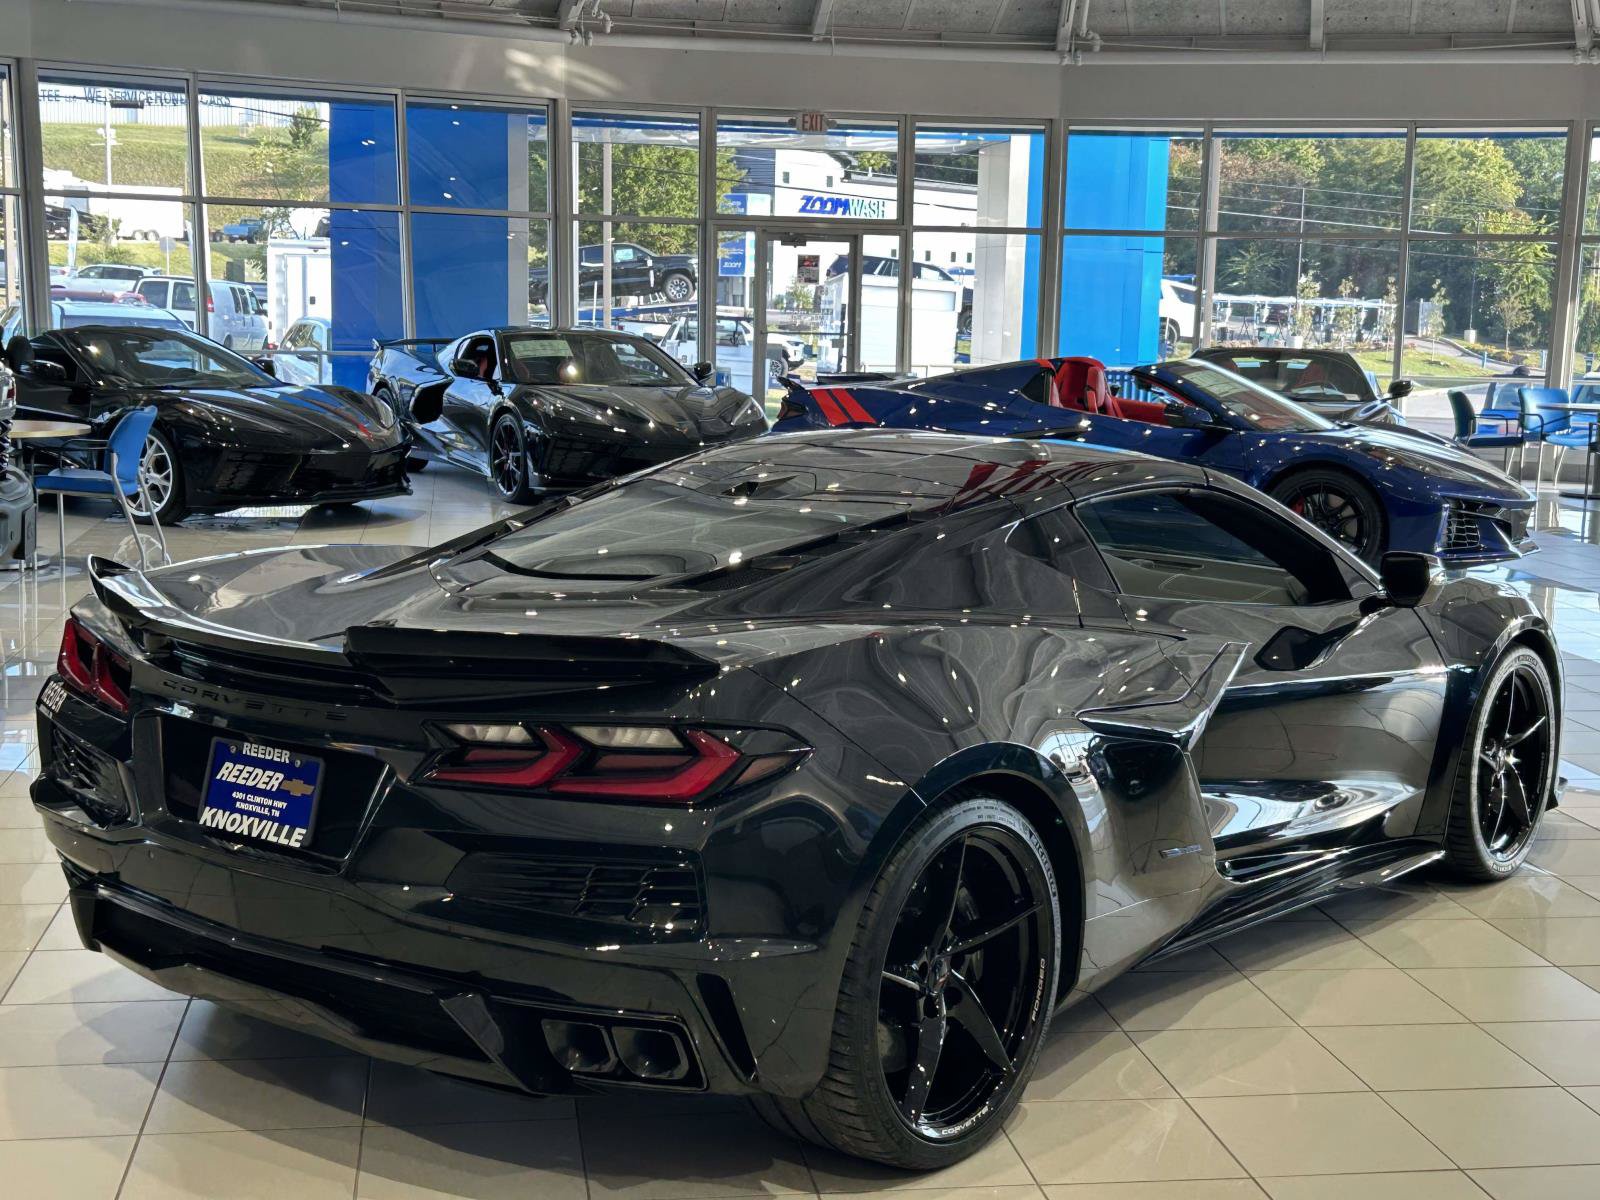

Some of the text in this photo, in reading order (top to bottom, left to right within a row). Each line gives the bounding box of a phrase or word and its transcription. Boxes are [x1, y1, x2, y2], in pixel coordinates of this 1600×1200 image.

[38, 89, 60, 102] TEE
[84, 87, 103, 104] WE
[108, 88, 152, 105] SERVICE
[155, 91, 187, 107] HOND
[200, 96, 231, 106] CARS
[802, 113, 824, 131] EXIT
[163, 680, 348, 721] CORVETTE
[242, 742, 291, 764] REEDER
[216, 761, 285, 792] REEDER
[246, 793, 273, 807] CLINTON
[273, 800, 288, 810] HWY
[271, 809, 280, 817] TN
[199, 806, 307, 848] KNOXVILLE
[941, 1105, 989, 1135] CORVETTE
